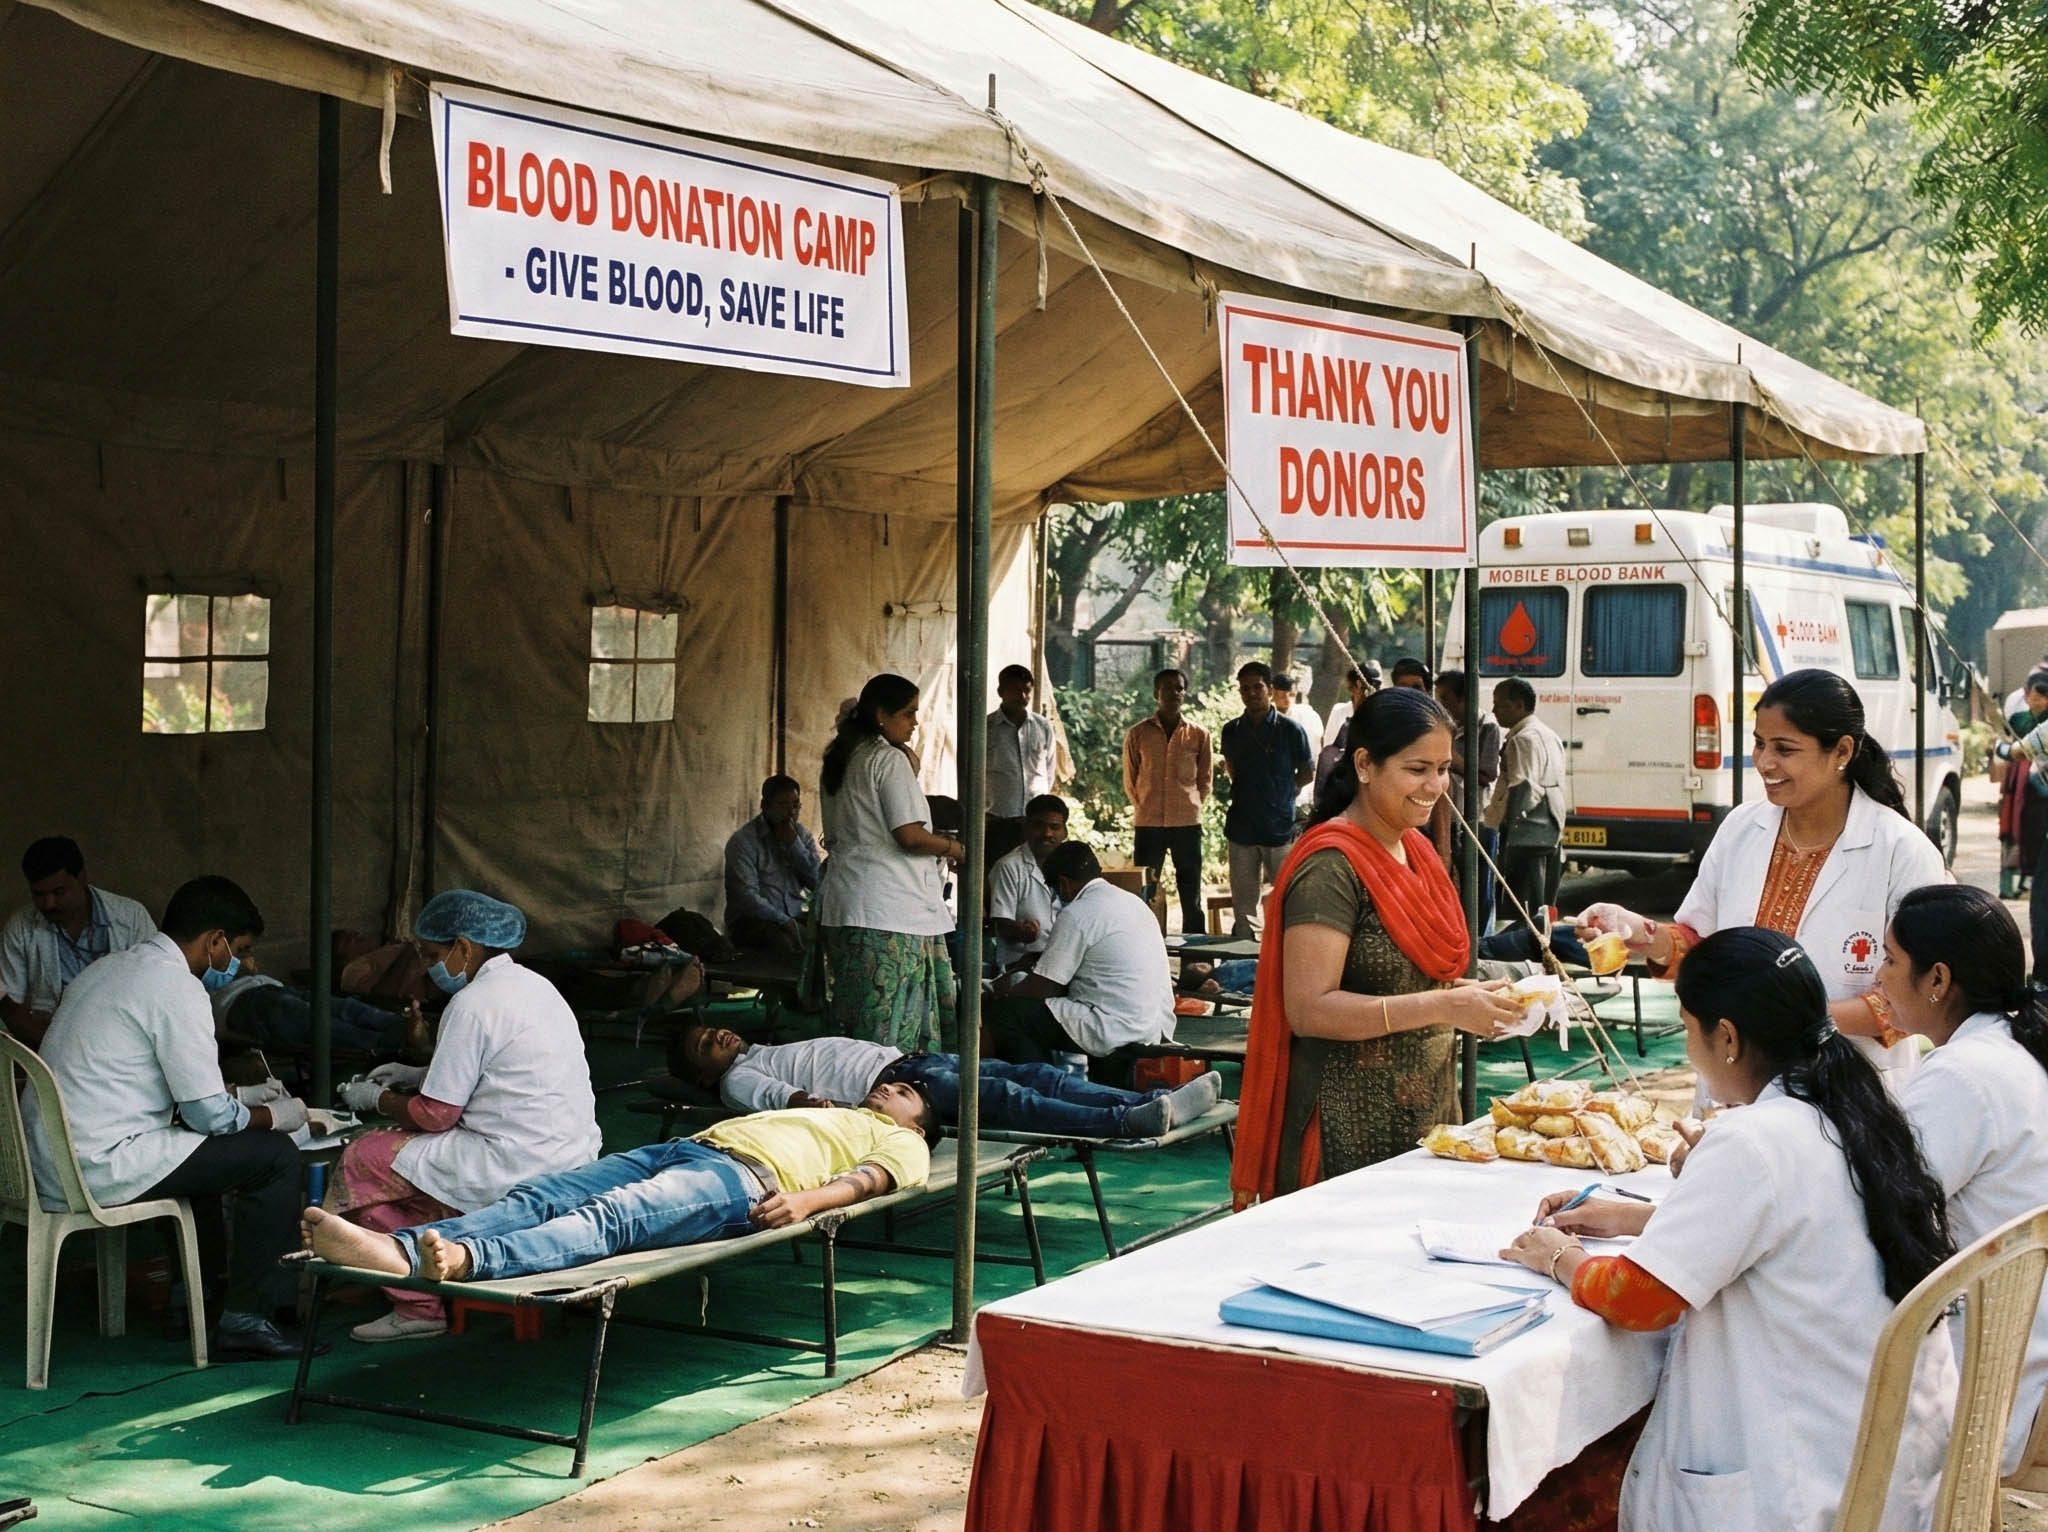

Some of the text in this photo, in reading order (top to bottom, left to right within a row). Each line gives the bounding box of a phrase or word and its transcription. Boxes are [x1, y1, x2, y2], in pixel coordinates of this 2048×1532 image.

[467, 141, 876, 276] BLOOD DONATION CAMP
[525, 246, 599, 302] GIVE
[608, 259, 711, 329] BLOOD,
[719, 277, 786, 330] SAVE
[794, 289, 845, 339] LIFE
[1242, 343, 1450, 435] THANK YOU
[1279, 446, 1426, 521] DONORS
[1488, 566, 1666, 583] MOBILE BLOOD BANK
